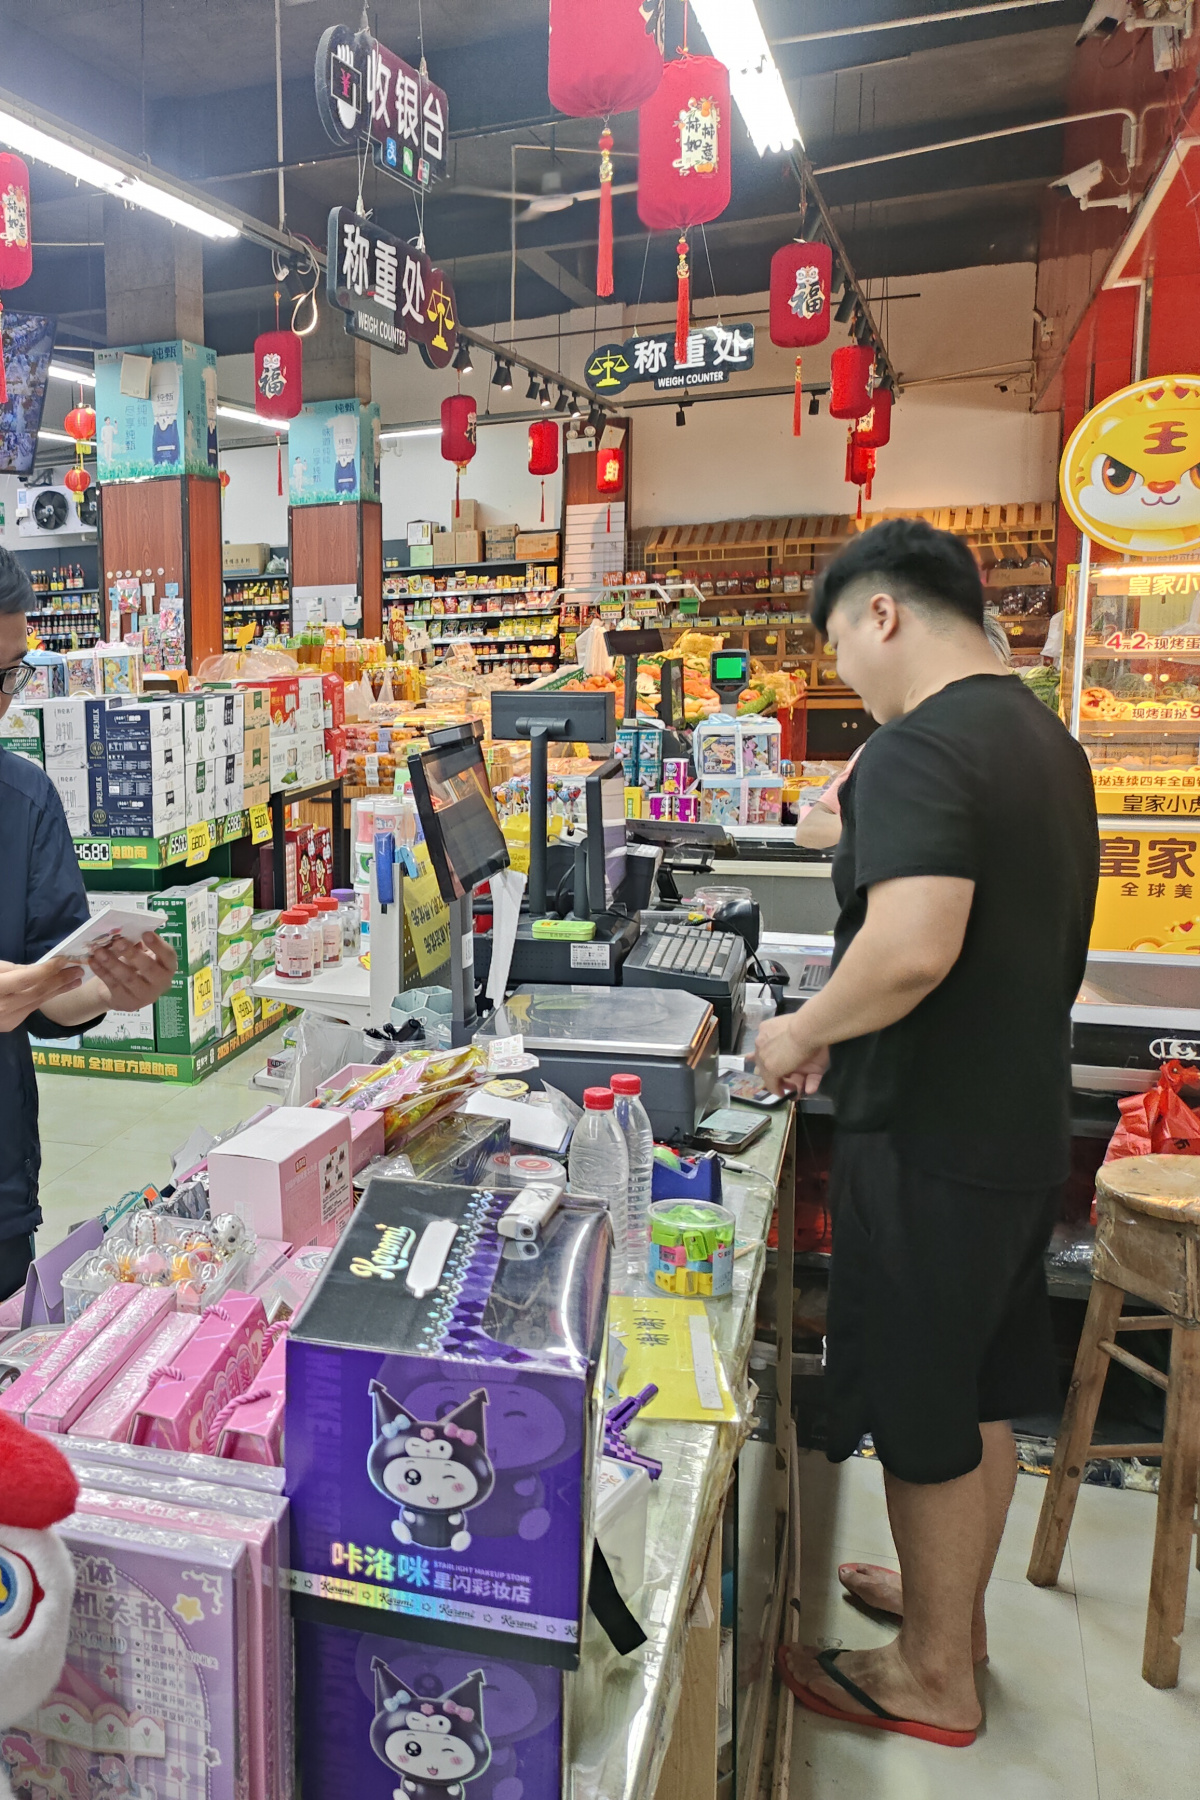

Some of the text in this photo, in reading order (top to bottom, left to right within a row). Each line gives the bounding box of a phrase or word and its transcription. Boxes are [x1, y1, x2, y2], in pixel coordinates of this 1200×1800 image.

[367, 49, 444, 161] 收银台
[343, 224, 425, 324] 称重处
[790, 282, 824, 318] 福
[358, 311, 406, 348] WEIGH COUNTER
[152, 346, 178, 359] 纯甄
[634, 329, 747, 374] 称重处
[259, 366, 286, 397] 福
[658, 371, 724, 388] WEIGH COUNTER
[1128, 574, 1198, 596] 皇家小
[1099, 837, 1196, 879] 皇家
[1121, 882, 1193, 899] 全球美
[48, 1052, 85, 1068] 世界杯
[89, 1057, 178, 1077] 全球官方赞助商
[330, 1542, 430, 1587] 咔洛咪
[434, 1561, 531, 1584] STARLIGHT MAKEUP STORE
[434, 1571, 531, 1604] 星闪彩妆店
